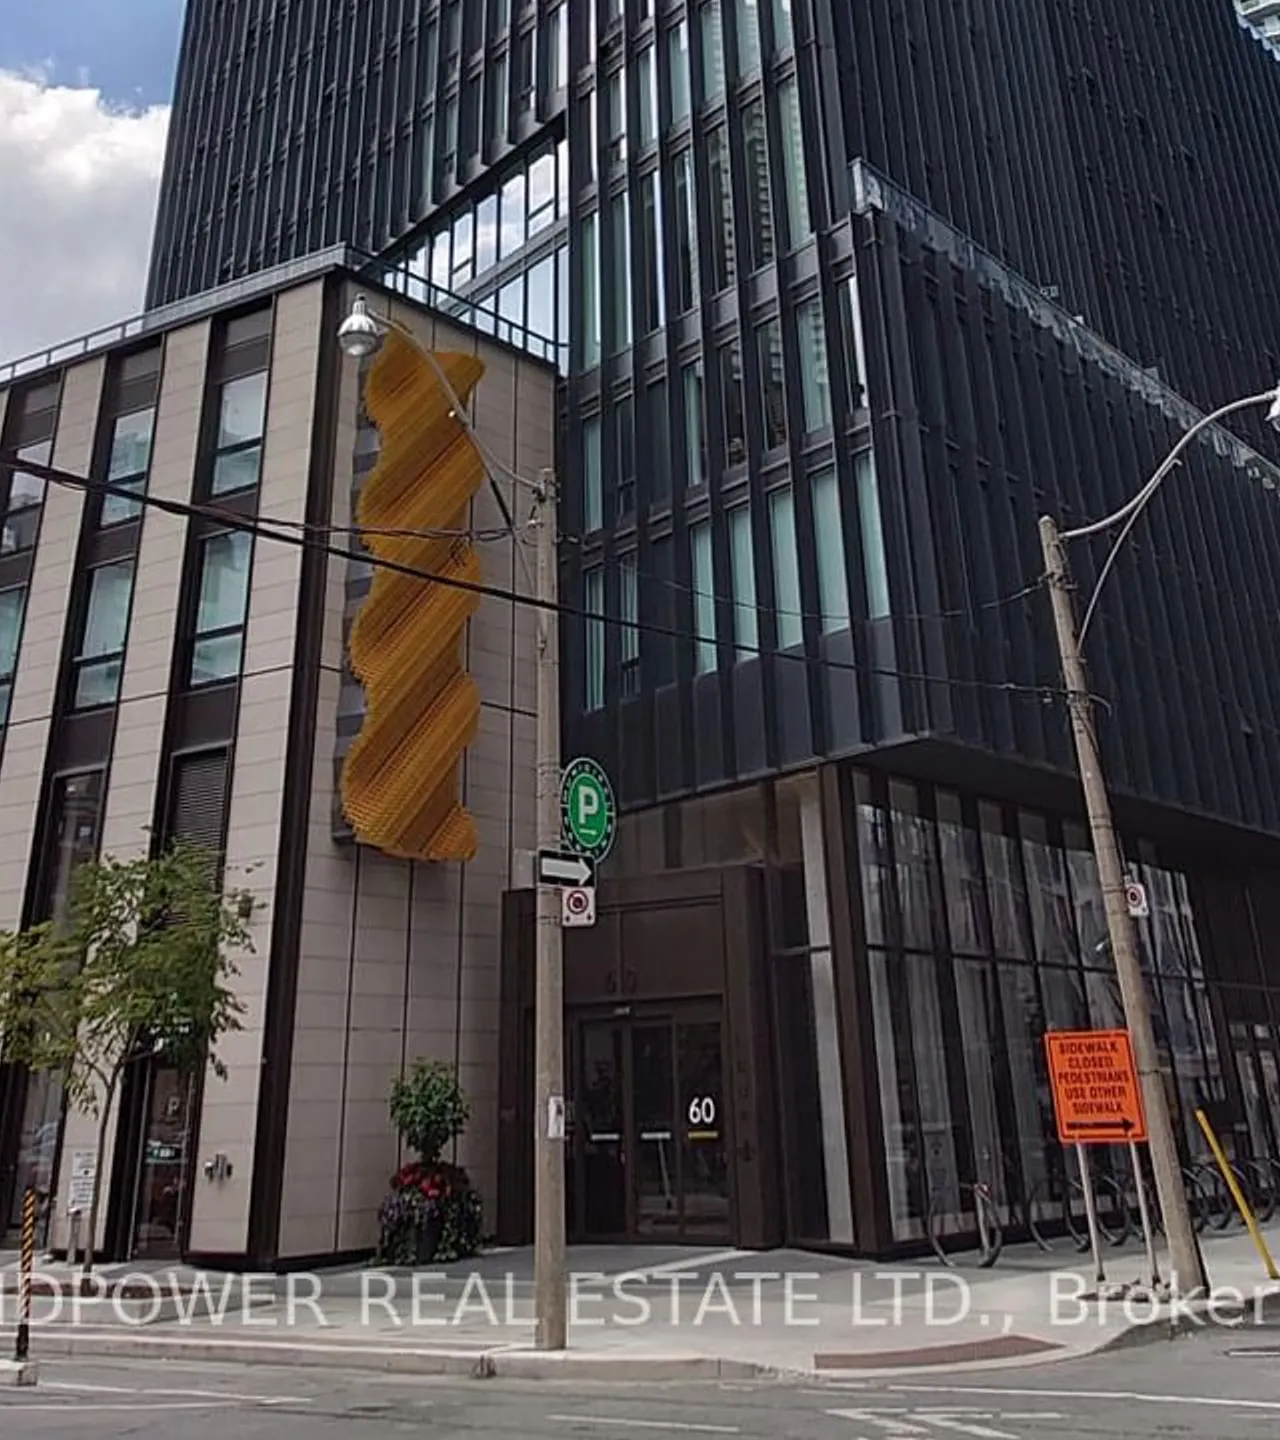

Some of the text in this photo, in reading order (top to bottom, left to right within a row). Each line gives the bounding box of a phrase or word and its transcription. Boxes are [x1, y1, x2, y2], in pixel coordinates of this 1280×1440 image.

[579, 785, 599, 824] P
[1059, 1041, 1118, 1055] SIDEWALK
[1068, 1056, 1113, 1069] CLOSED
[1058, 1071, 1130, 1085] PEDESTRIANS
[1064, 1086, 1127, 1100] USE OTHER
[688, 1097, 716, 1124] 60
[1072, 1101, 1124, 1115] SIDEWALK
